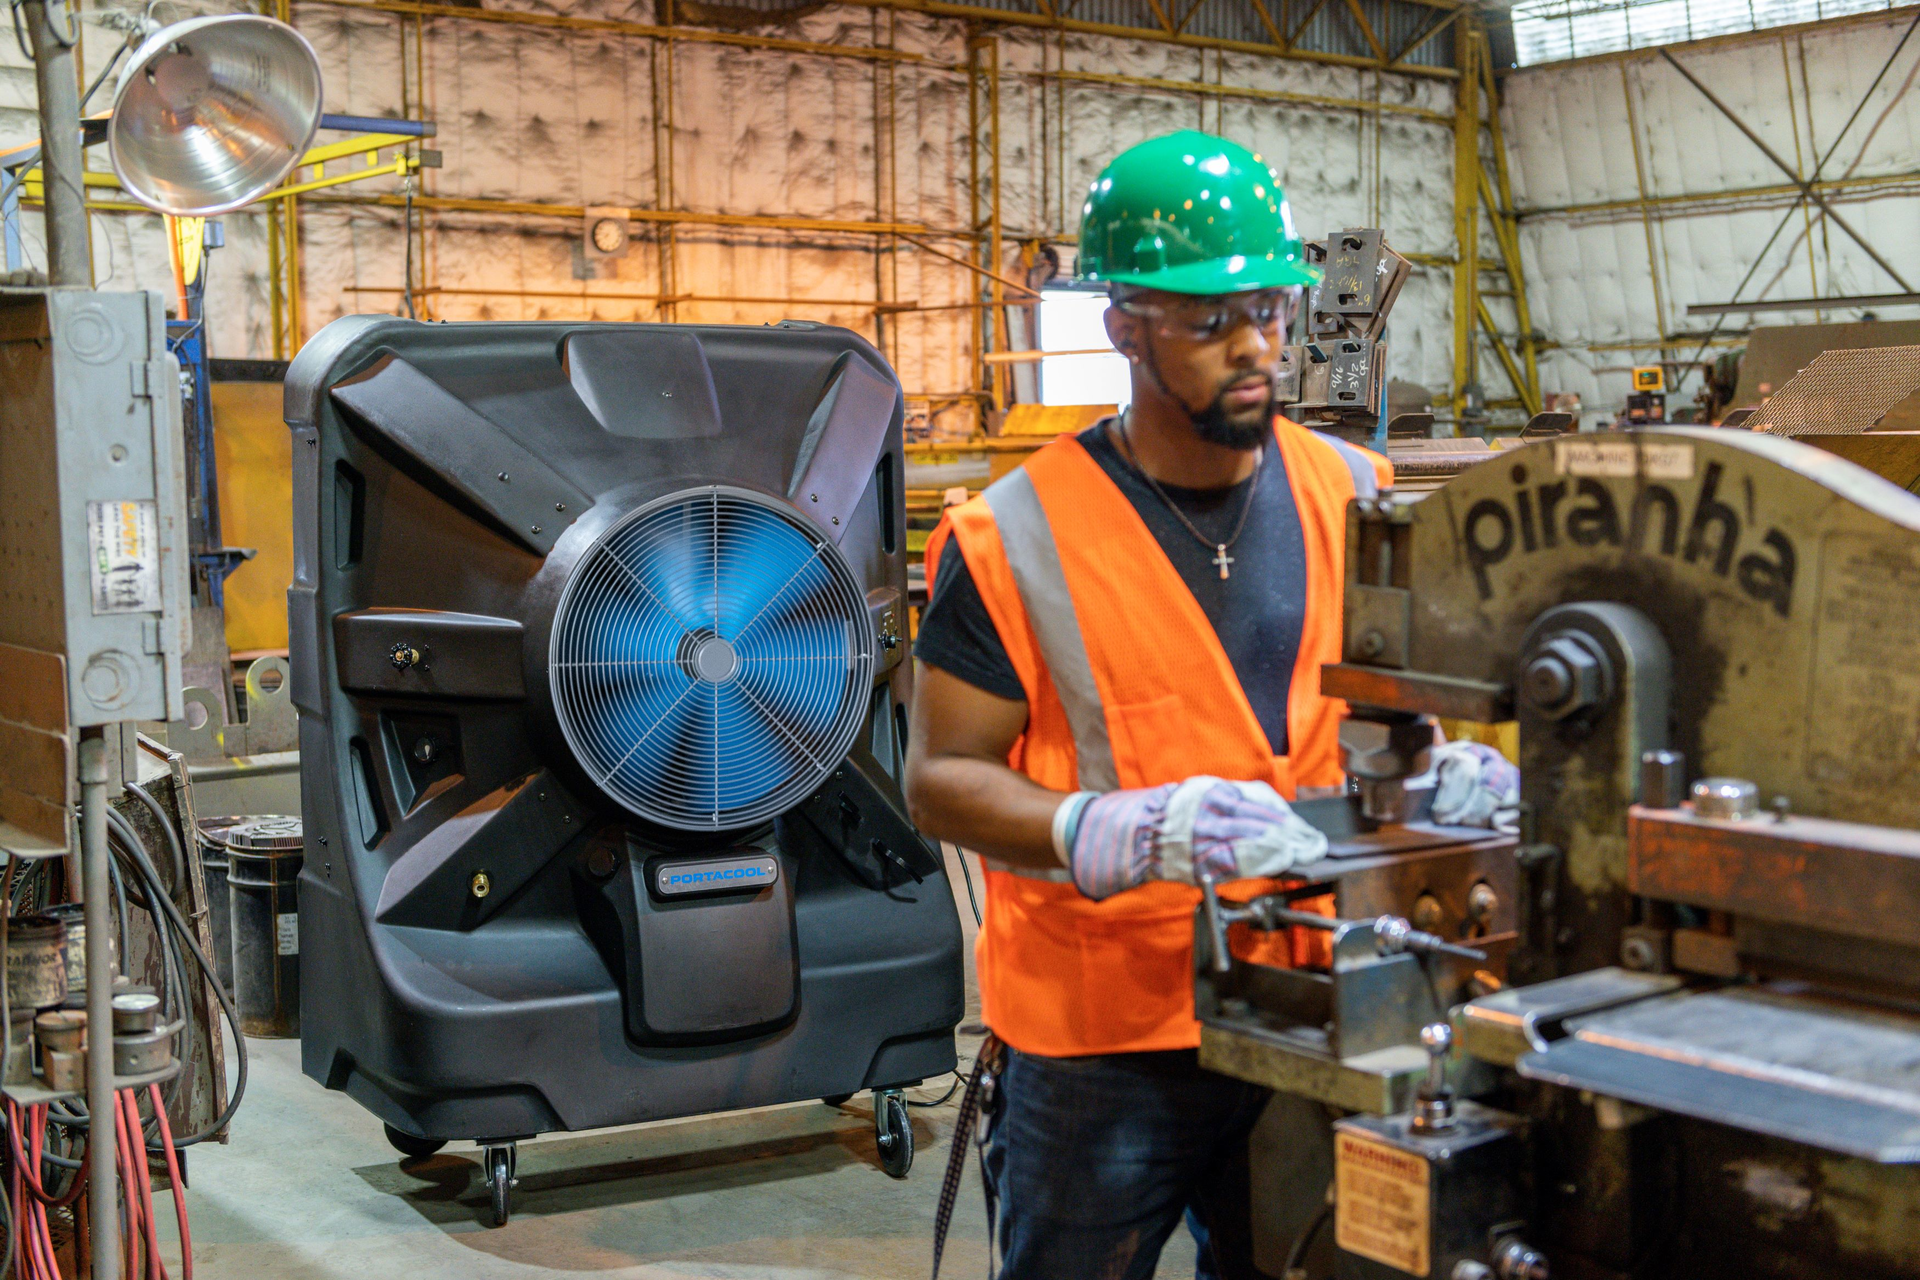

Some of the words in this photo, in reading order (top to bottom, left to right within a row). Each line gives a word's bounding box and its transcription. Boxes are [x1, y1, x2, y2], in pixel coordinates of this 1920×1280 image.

[121, 502, 138, 558] SAFETY
[1464, 459, 1797, 618] piranha
[670, 866, 766, 885] PORTACOOL
